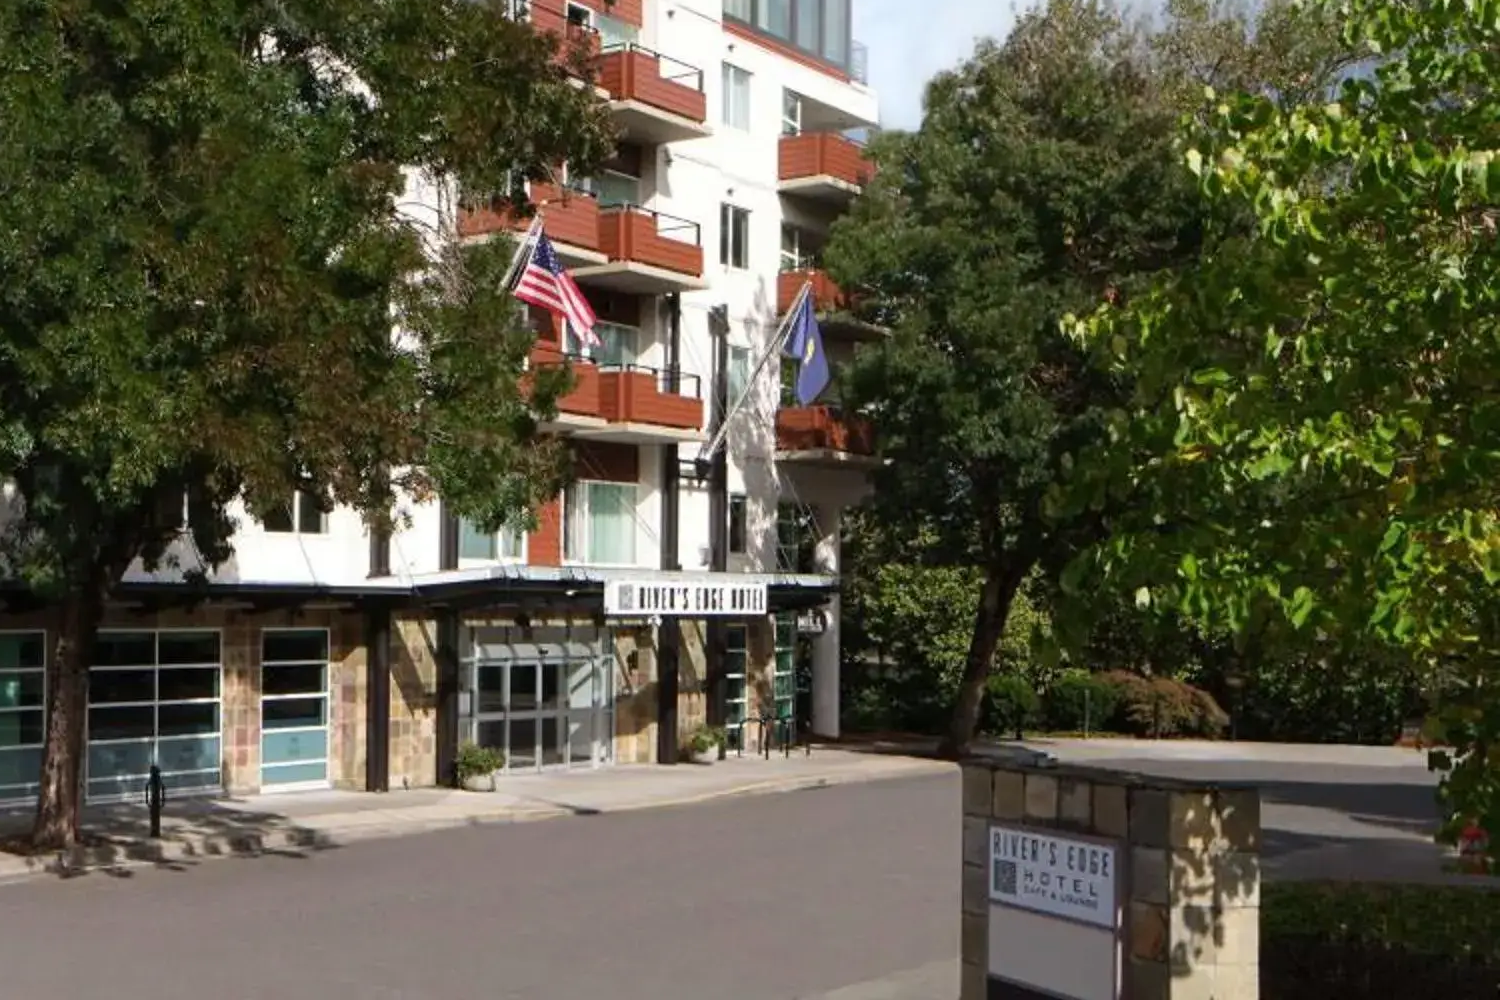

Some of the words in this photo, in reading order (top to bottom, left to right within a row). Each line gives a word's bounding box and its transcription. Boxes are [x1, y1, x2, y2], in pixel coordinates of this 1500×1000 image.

[639, 587, 689, 611] RIVER'S
[993, 832, 1058, 867] RIVER'S
[1067, 845, 1110, 878] EDGE
[1023, 867, 1099, 897] HOTEL
